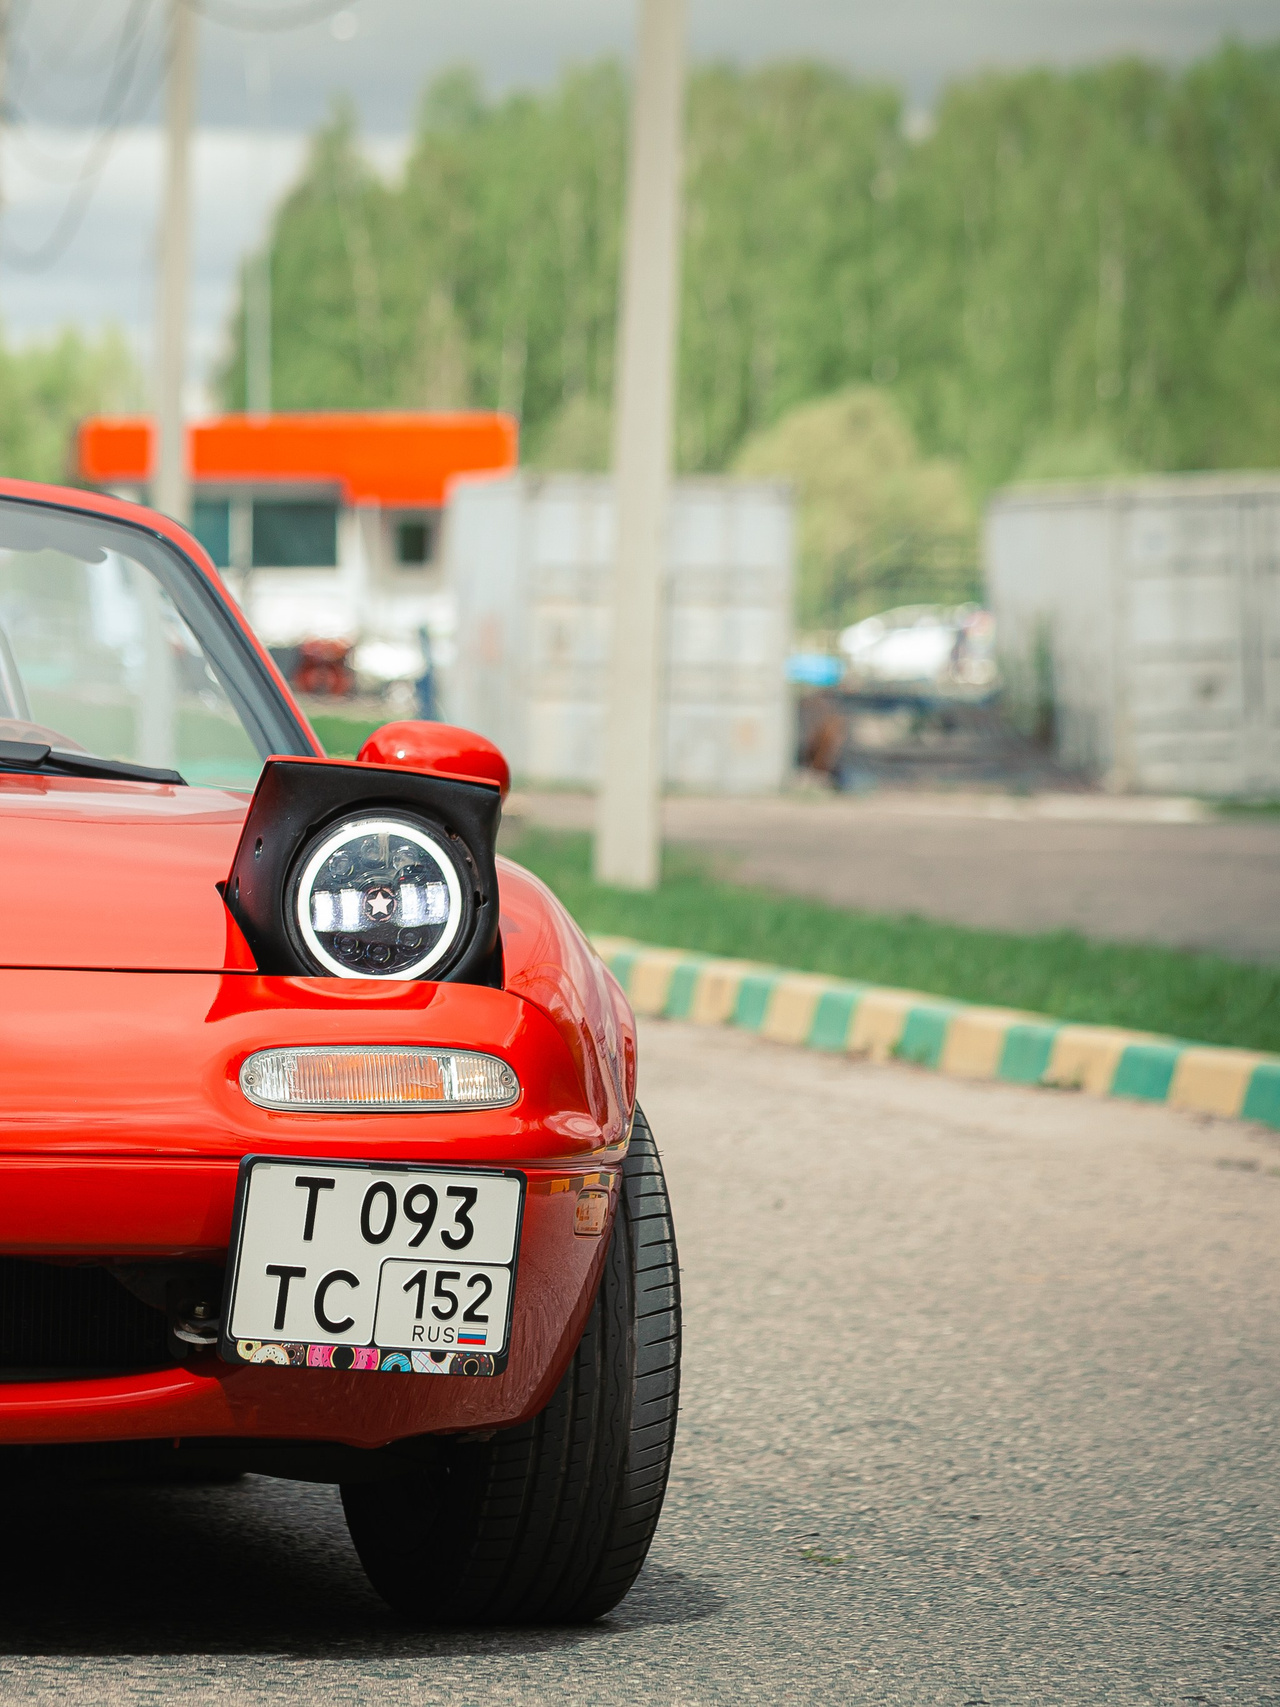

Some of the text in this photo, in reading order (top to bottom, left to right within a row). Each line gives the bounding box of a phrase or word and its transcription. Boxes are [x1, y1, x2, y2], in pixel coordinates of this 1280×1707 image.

[294, 1176, 478, 1251] T 093
[265, 1264, 360, 1334] TC
[402, 1269, 493, 1324] 152
[411, 1325, 455, 1344] RUS
